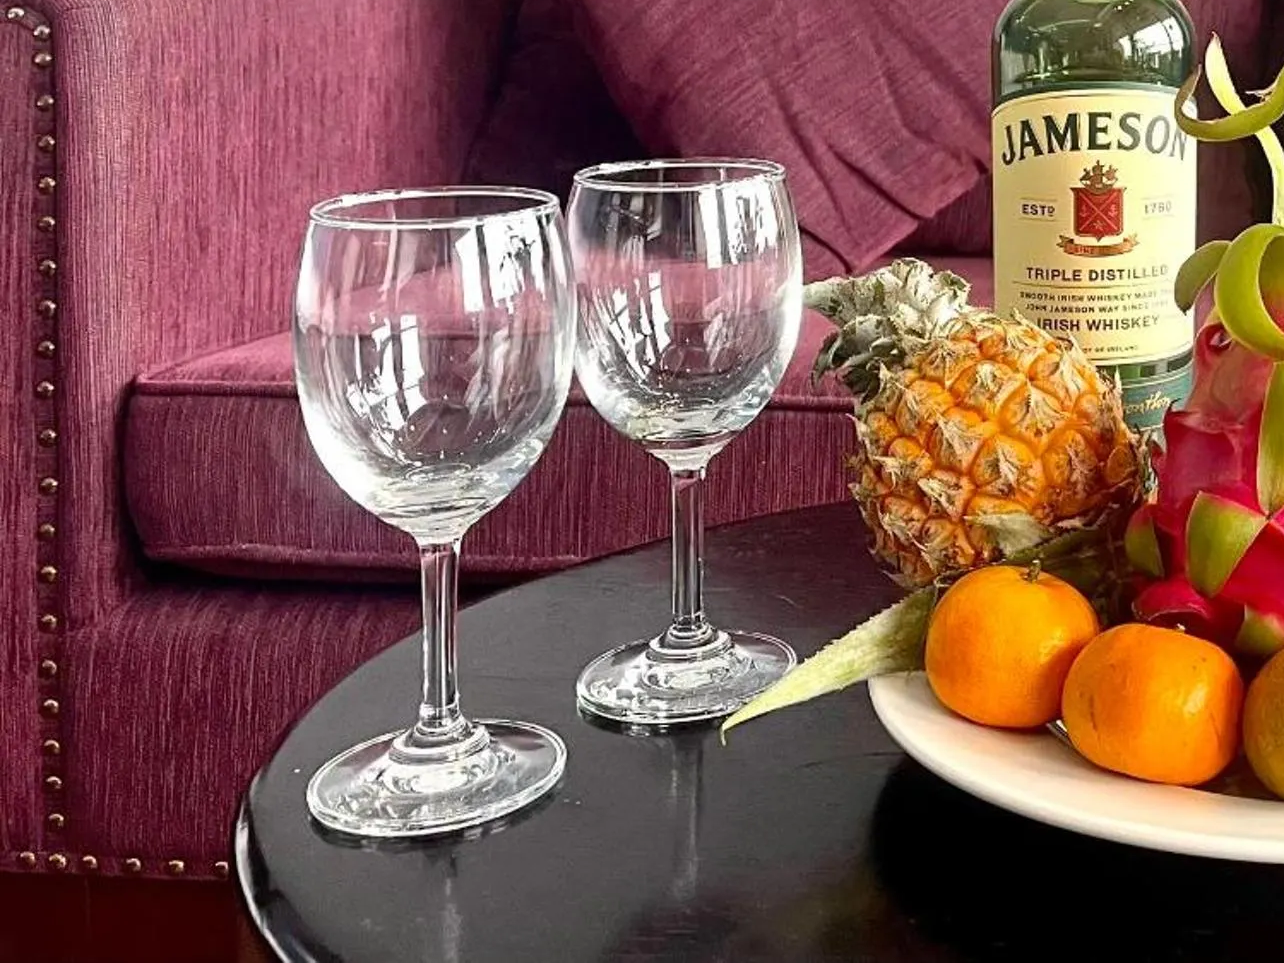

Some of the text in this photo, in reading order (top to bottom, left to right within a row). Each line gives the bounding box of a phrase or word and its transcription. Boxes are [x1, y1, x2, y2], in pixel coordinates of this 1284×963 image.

[1001, 111, 1187, 165] JAMESON
[1026, 265, 1169, 281] TRIPLE DISTILLED
[1020, 291, 1055, 301] SMOOTH
[1057, 294, 1084, 302] IRISH
[1086, 293, 1132, 302] WHISKEY
[1025, 303, 1047, 312] JOHN
[1049, 305, 1095, 313] JAMESON
[1098, 305, 1119, 313] WAY
[1122, 302, 1149, 312] SINCE
[1036, 315, 1160, 331] IRISH WHISKEY
